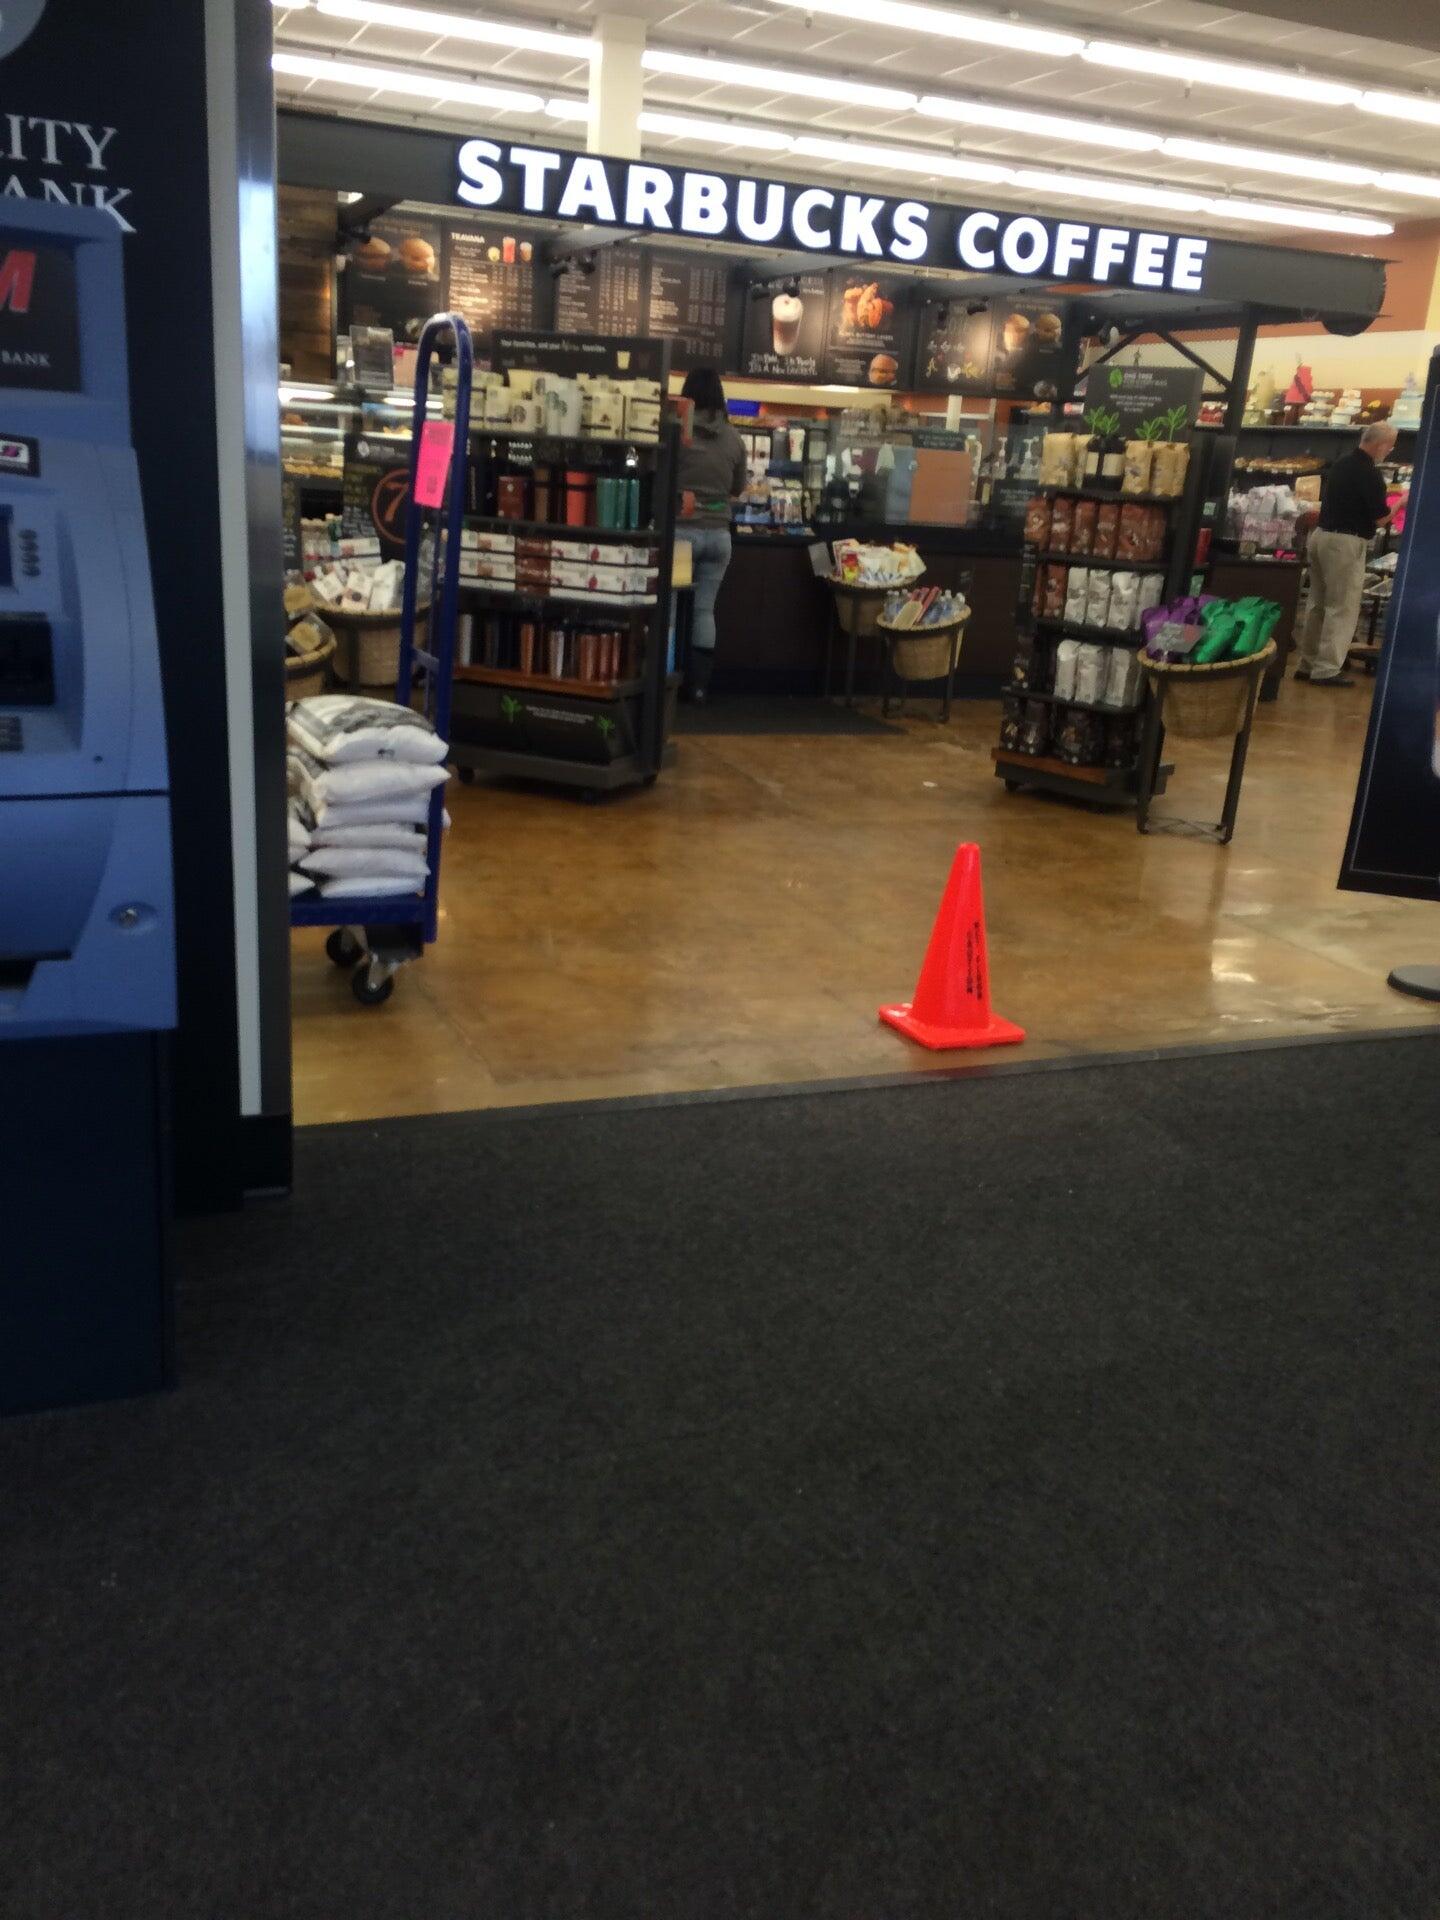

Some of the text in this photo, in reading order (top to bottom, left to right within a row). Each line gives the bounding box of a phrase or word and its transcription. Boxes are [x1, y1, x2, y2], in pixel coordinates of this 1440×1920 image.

[0, 113, 118, 171] ITY
[456, 138, 1209, 291] STARBUCKS COFFEE
